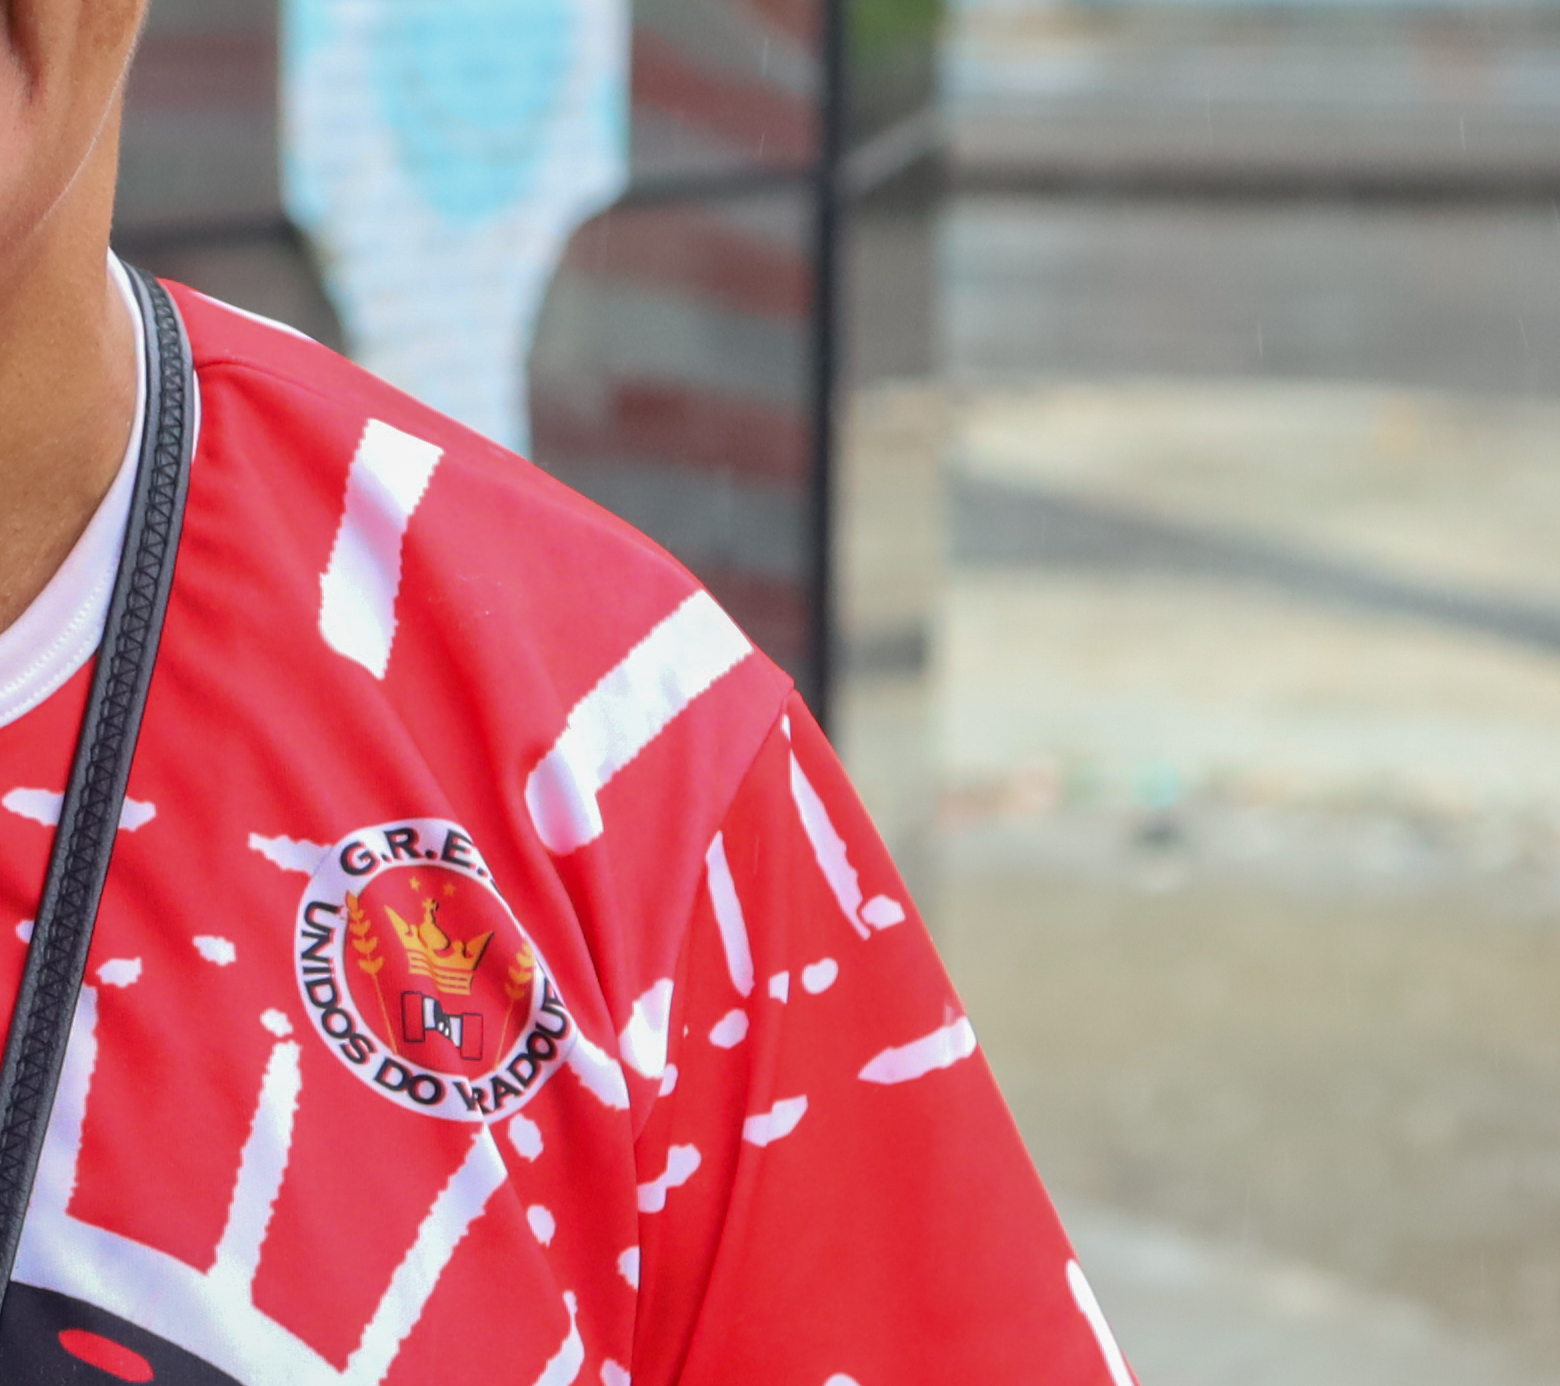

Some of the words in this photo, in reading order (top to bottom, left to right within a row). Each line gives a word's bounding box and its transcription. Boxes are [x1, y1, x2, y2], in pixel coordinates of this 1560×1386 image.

[340, 827, 496, 879] G.R.E.
[301, 900, 377, 1066] UNIDOS
[374, 1056, 443, 1106] DO
